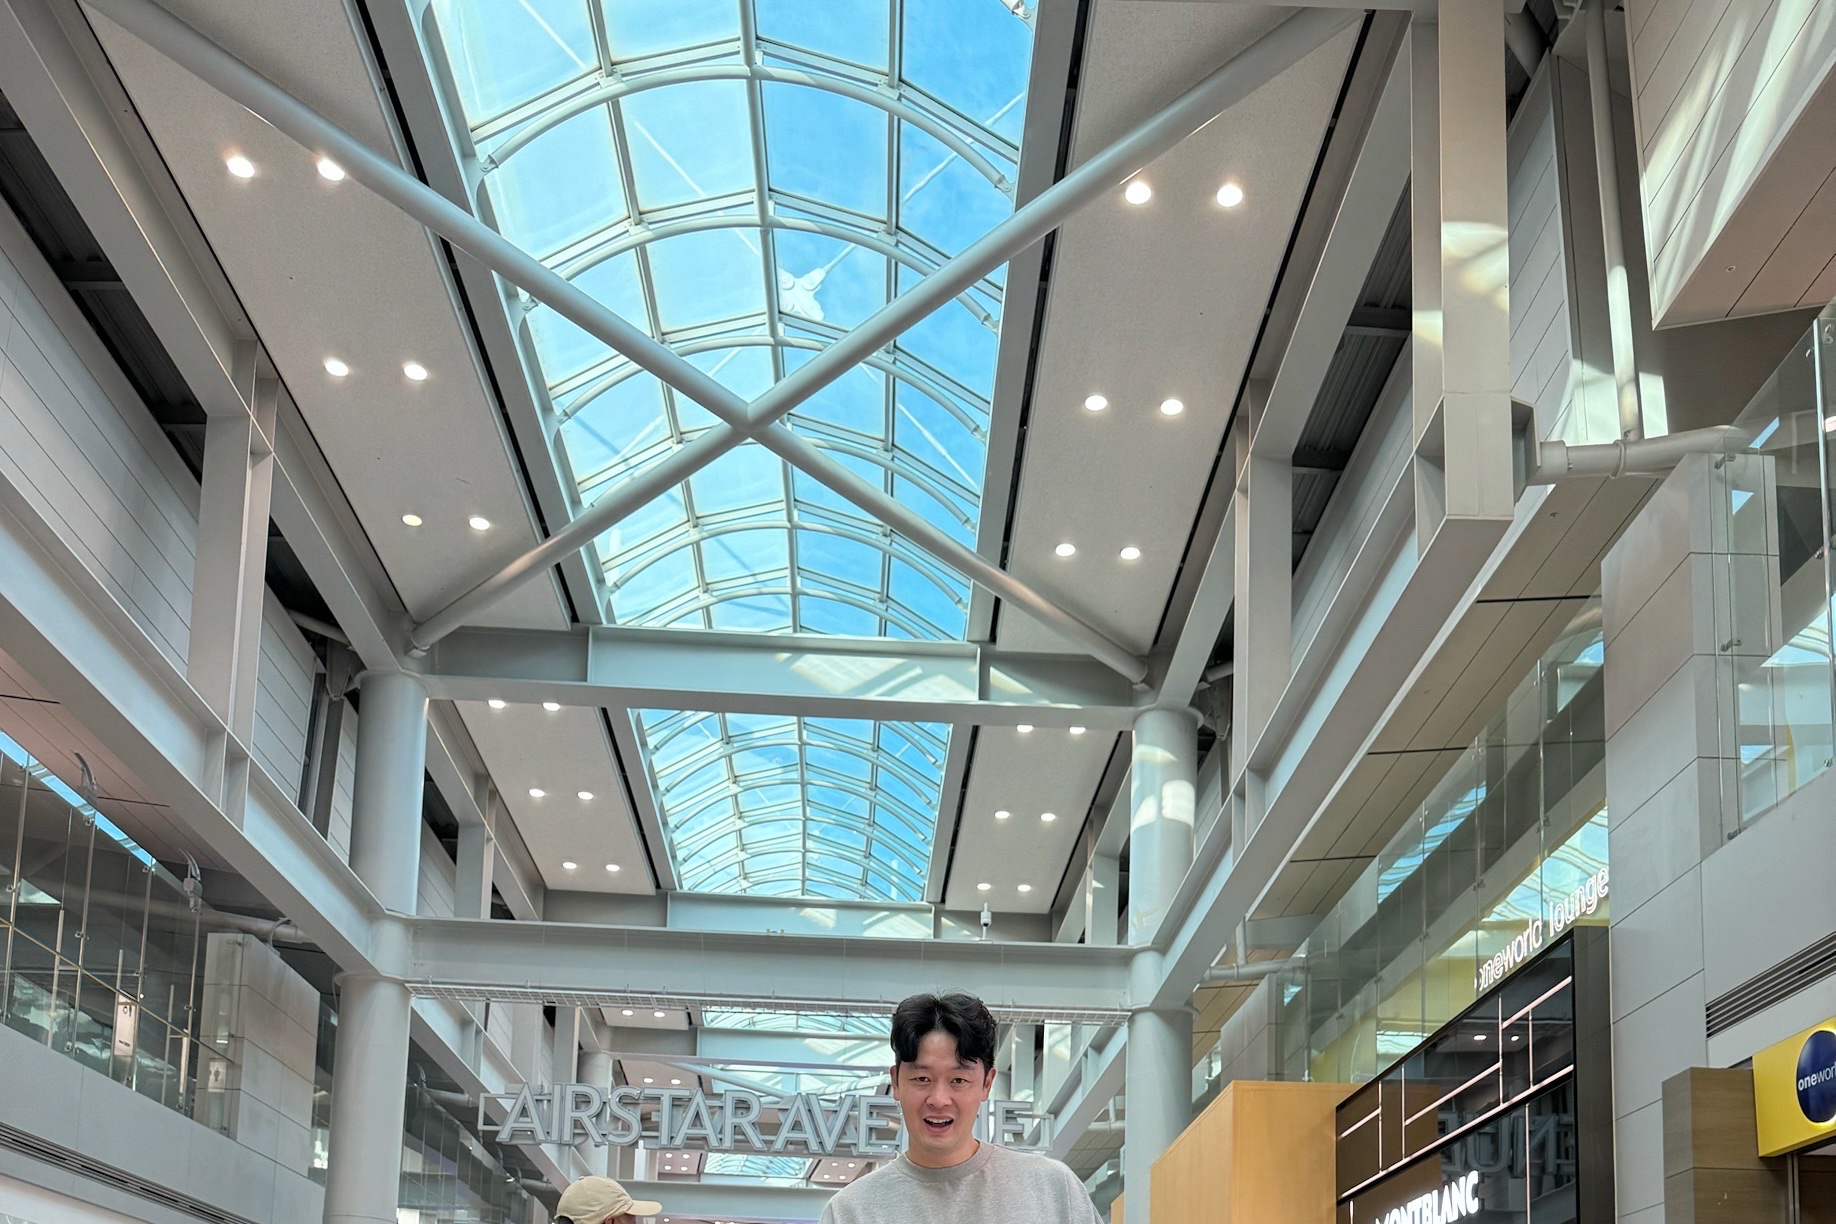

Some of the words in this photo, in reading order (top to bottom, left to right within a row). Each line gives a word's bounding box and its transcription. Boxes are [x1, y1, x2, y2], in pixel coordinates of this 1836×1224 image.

[1548, 866, 1610, 938] lounge
[1797, 1061, 1836, 1091] oneworl
[496, 1081, 766, 1150] AIRSTAR
[770, 1091, 1034, 1155] AVEE
